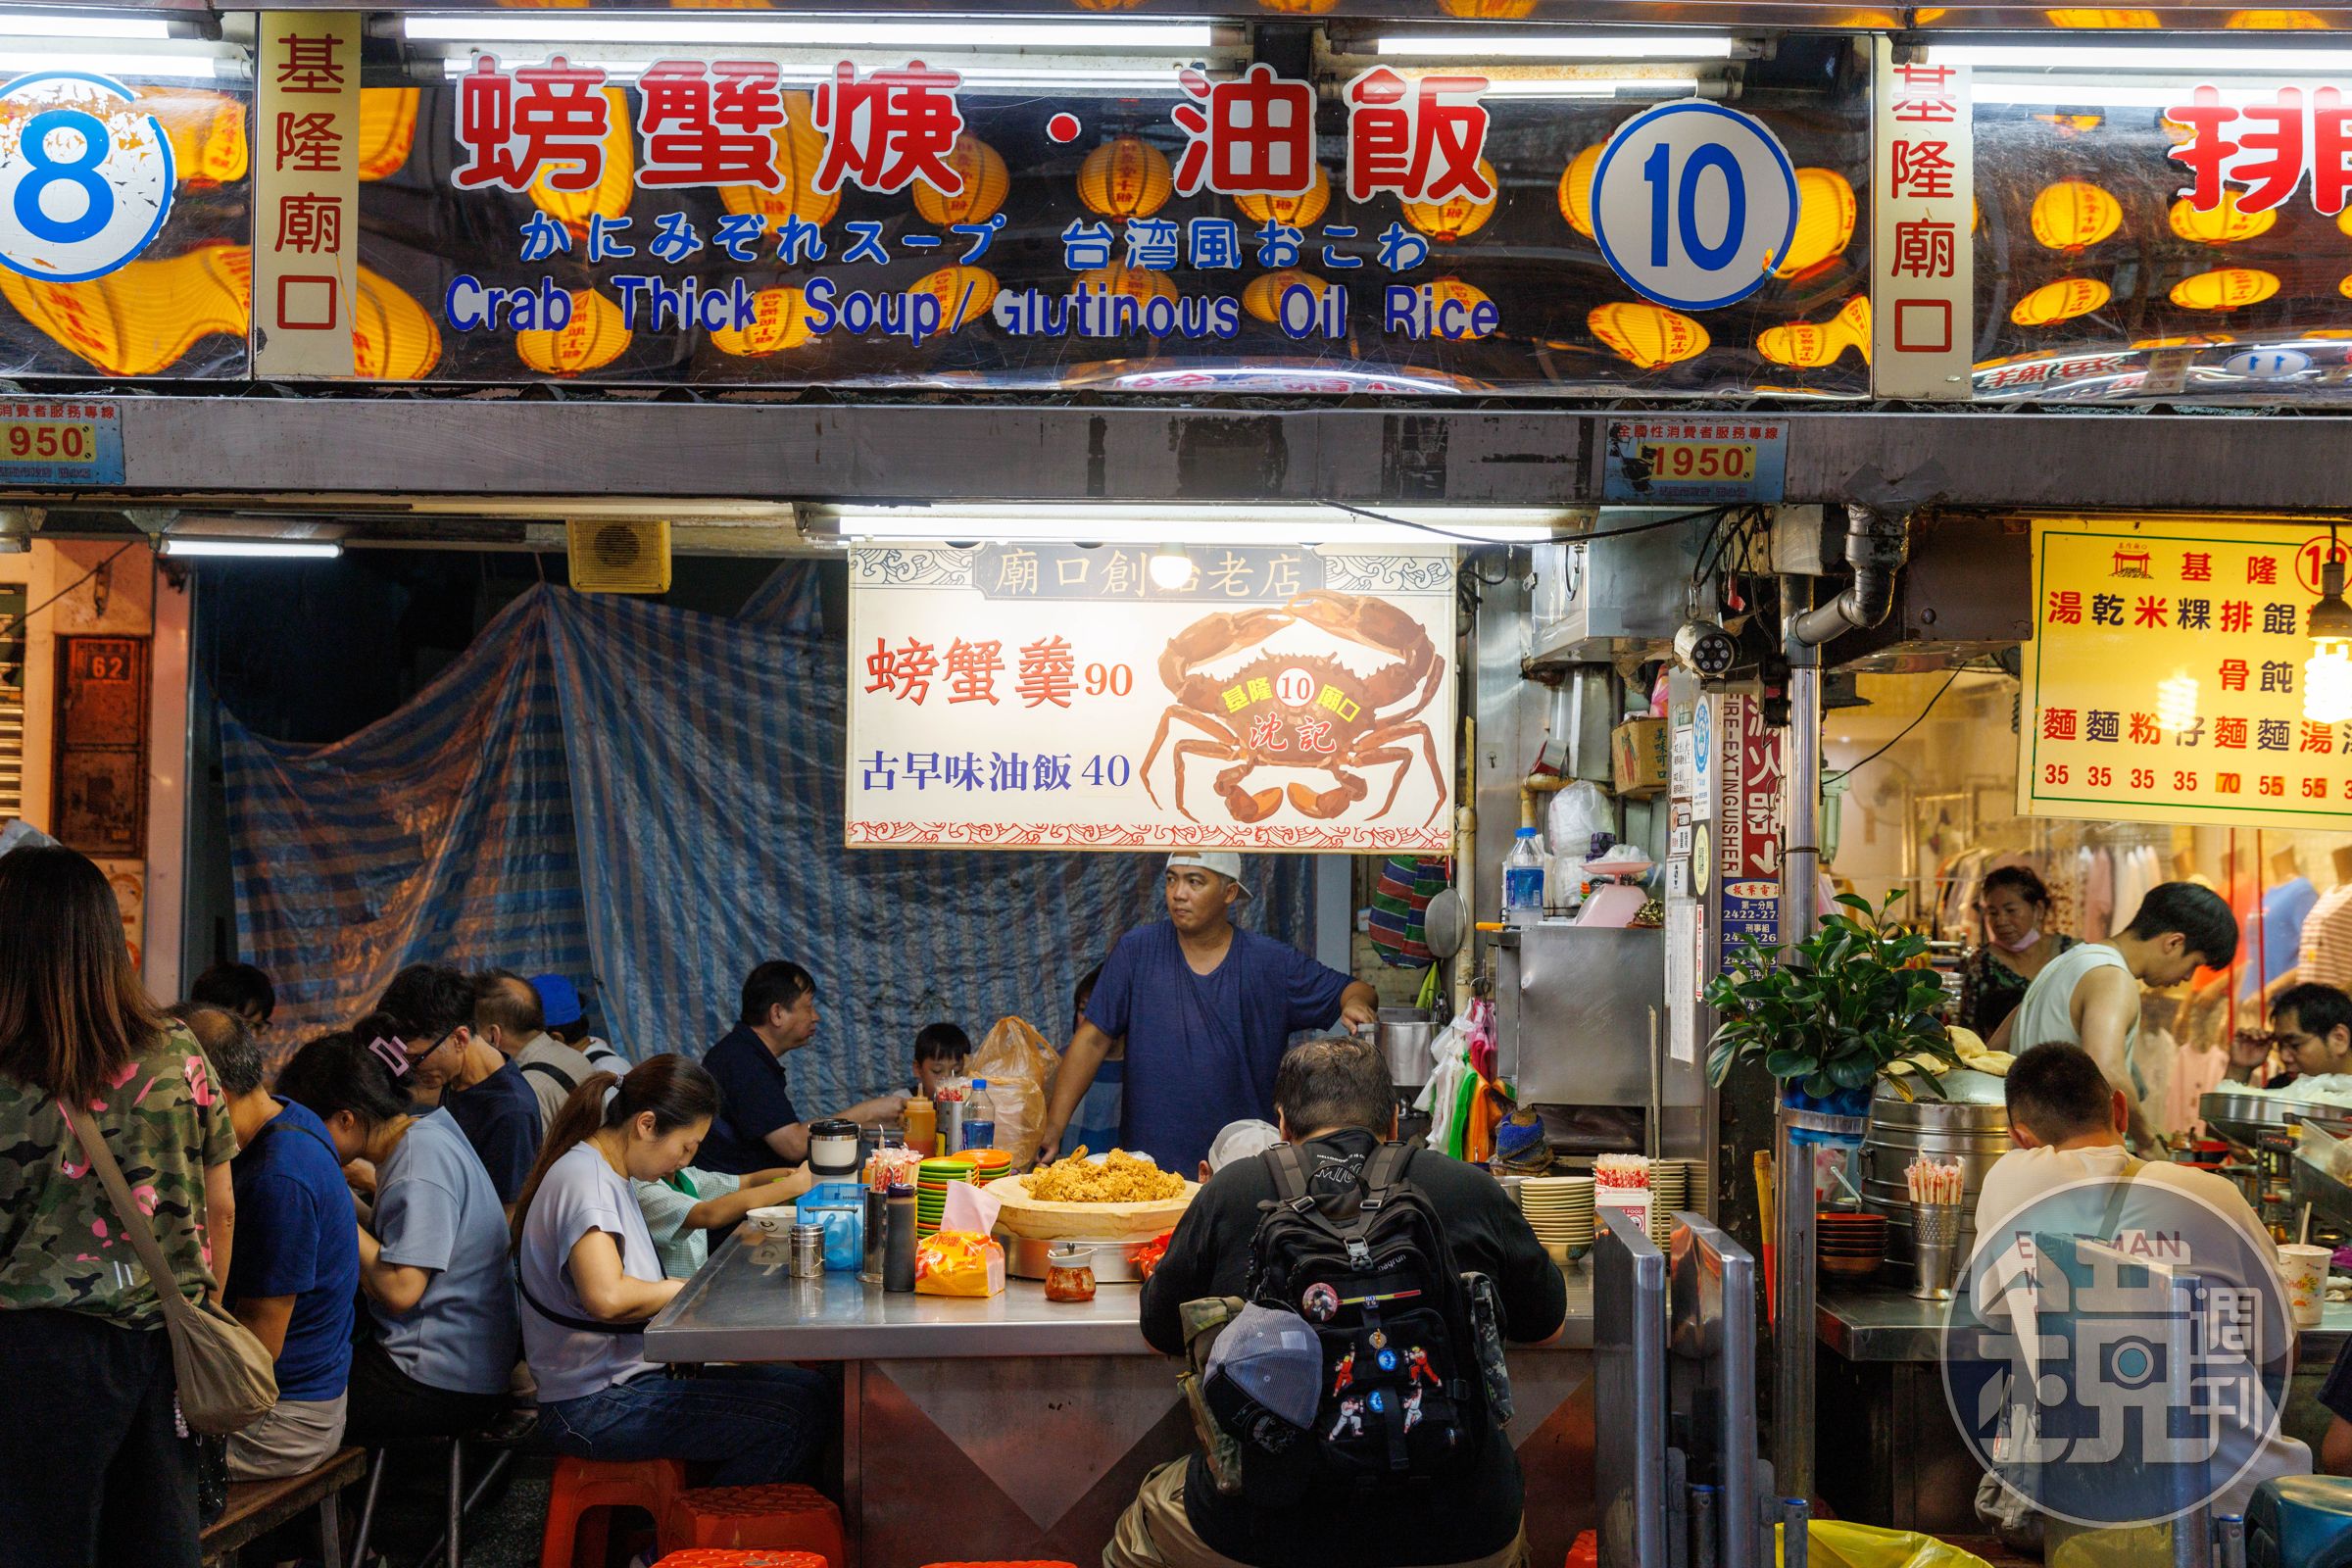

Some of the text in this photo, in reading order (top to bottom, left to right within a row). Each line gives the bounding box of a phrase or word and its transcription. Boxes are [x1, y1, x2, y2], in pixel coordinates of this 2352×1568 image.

[456, 55, 964, 195] 螃蟹焿
[1174, 66, 1494, 202] 油飯
[14, 110, 114, 244] 8
[275, 33, 344, 330] 基隆廟口
[1643, 142, 1746, 271] 10
[1891, 64, 1957, 353] 基隆廟口
[520, 211, 1429, 271] かにみぞれスープ 台湾風おこわ
[446, 276, 572, 331] Crab
[611, 277, 758, 331] Thick
[1280, 283, 1346, 339] Oil
[1385, 284, 1499, 339] Rice
[1617, 424, 1779, 440] 全國性消費者服務專線
[1654, 447, 1743, 476] 1950
[92, 657, 122, 678] 62
[863, 634, 1133, 709] 螃蟹羹 90
[1221, 676, 1273, 713] 基隆
[1281, 676, 1311, 700] 10
[1315, 683, 1361, 723] 廟口
[1249, 710, 1337, 753] 沈記
[858, 750, 1131, 792] 古早味油飯 40
[2044, 764, 2069, 785] 35
[2087, 766, 2112, 787] 35
[2130, 769, 2155, 789] 35
[2173, 771, 2198, 792] 35
[2218, 772, 2241, 794] 70
[2259, 775, 2284, 797] 55
[2302, 778, 2328, 799] 55
[1723, 909, 1779, 919] 2422-27
